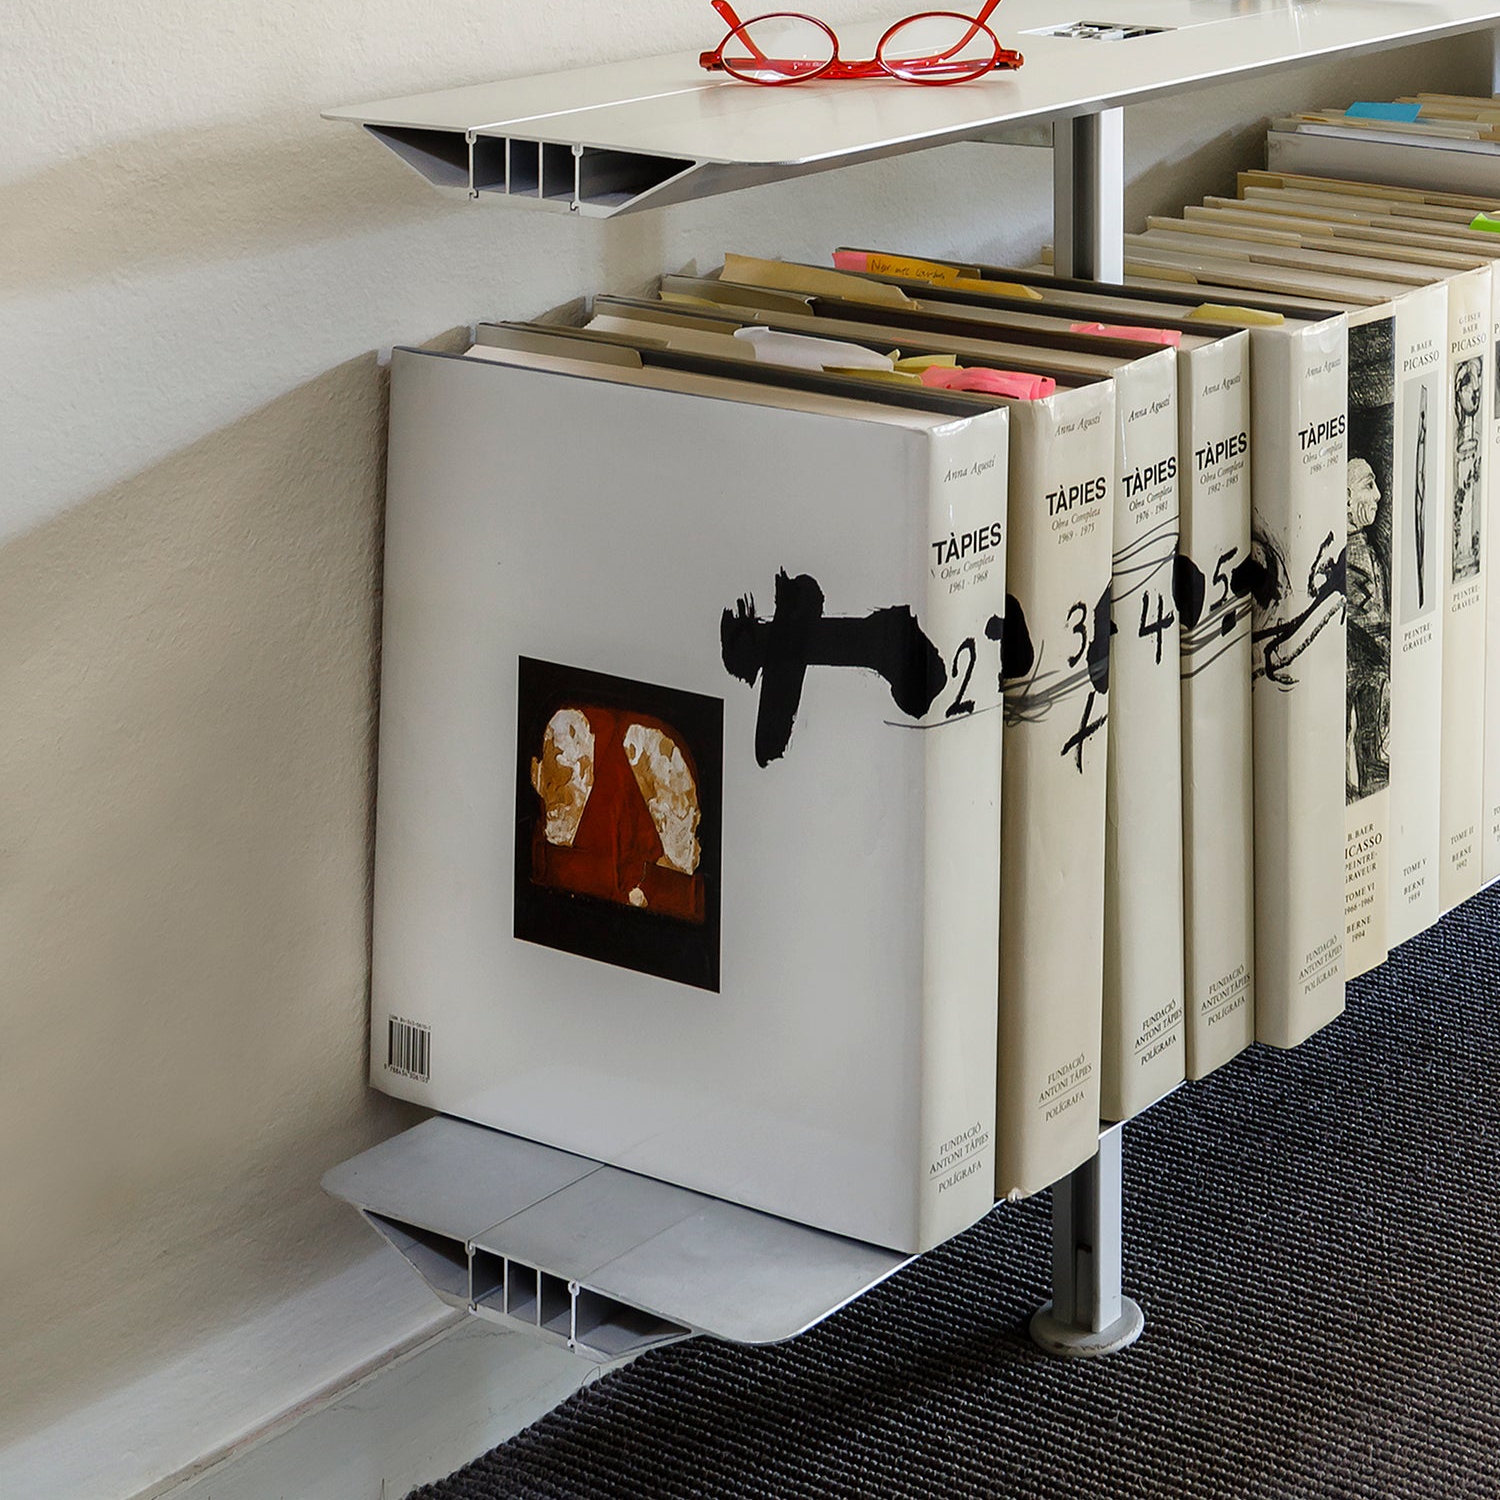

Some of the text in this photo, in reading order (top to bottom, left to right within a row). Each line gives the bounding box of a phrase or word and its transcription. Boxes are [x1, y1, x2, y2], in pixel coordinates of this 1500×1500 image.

[1451, 333, 1487, 354] PICASSO
[1403, 350, 1440, 372] PICASSO
[1298, 414, 1346, 450] TÀPIES
[1195, 432, 1247, 471] TÀPIES
[944, 465, 967, 482] Anna
[1122, 456, 1177, 498] TÀPIES
[1046, 477, 1107, 516] TÀPIES
[1128, 497, 1145, 512] Obra
[1052, 516, 1069, 531] Obra
[932, 522, 1001, 565] TÀPIES
[941, 554, 995, 579] Obra Completa
[1209, 546, 1240, 611] 5
[1451, 595, 1480, 613] GRAVEUR
[1066, 600, 1088, 668] 3
[1139, 589, 1175, 665] 4
[1402, 633, 1432, 653] GRAVEUR
[946, 637, 976, 718] 2
[1355, 823, 1374, 840] BAER
[1344, 832, 1382, 860] ICASSO
[1452, 845, 1472, 862] BERNE
[1403, 863, 1421, 877] TOME
[1345, 887, 1365, 903] TOME
[1403, 878, 1425, 896] BERNE
[1346, 915, 1371, 934] BERNE
[1305, 934, 1338, 963] FUNDACIÓ
[1208, 964, 1244, 995] FUNDACIÓ
[1298, 957, 1324, 980] ANTONI
[1304, 965, 1338, 995] POLÍGRAFA
[1201, 986, 1230, 1011] ANTONI
[1207, 997, 1245, 1026] POLÍGRAFA
[1142, 999, 1176, 1031] FUNDACIÓ
[1134, 1023, 1162, 1049] ANTONI
[1141, 1035, 1177, 1066] POLÍGRAFA
[1047, 1052, 1085, 1084] FUNDACIÓ
[1038, 1080, 1068, 1103] ANTONI
[1045, 1091, 1084, 1122] POLÍGRAFA
[939, 1122, 982, 1155] FUNDACIÓ
[929, 1149, 963, 1174] ANTONI
[938, 1161, 982, 1193] POLÍGRAFA
